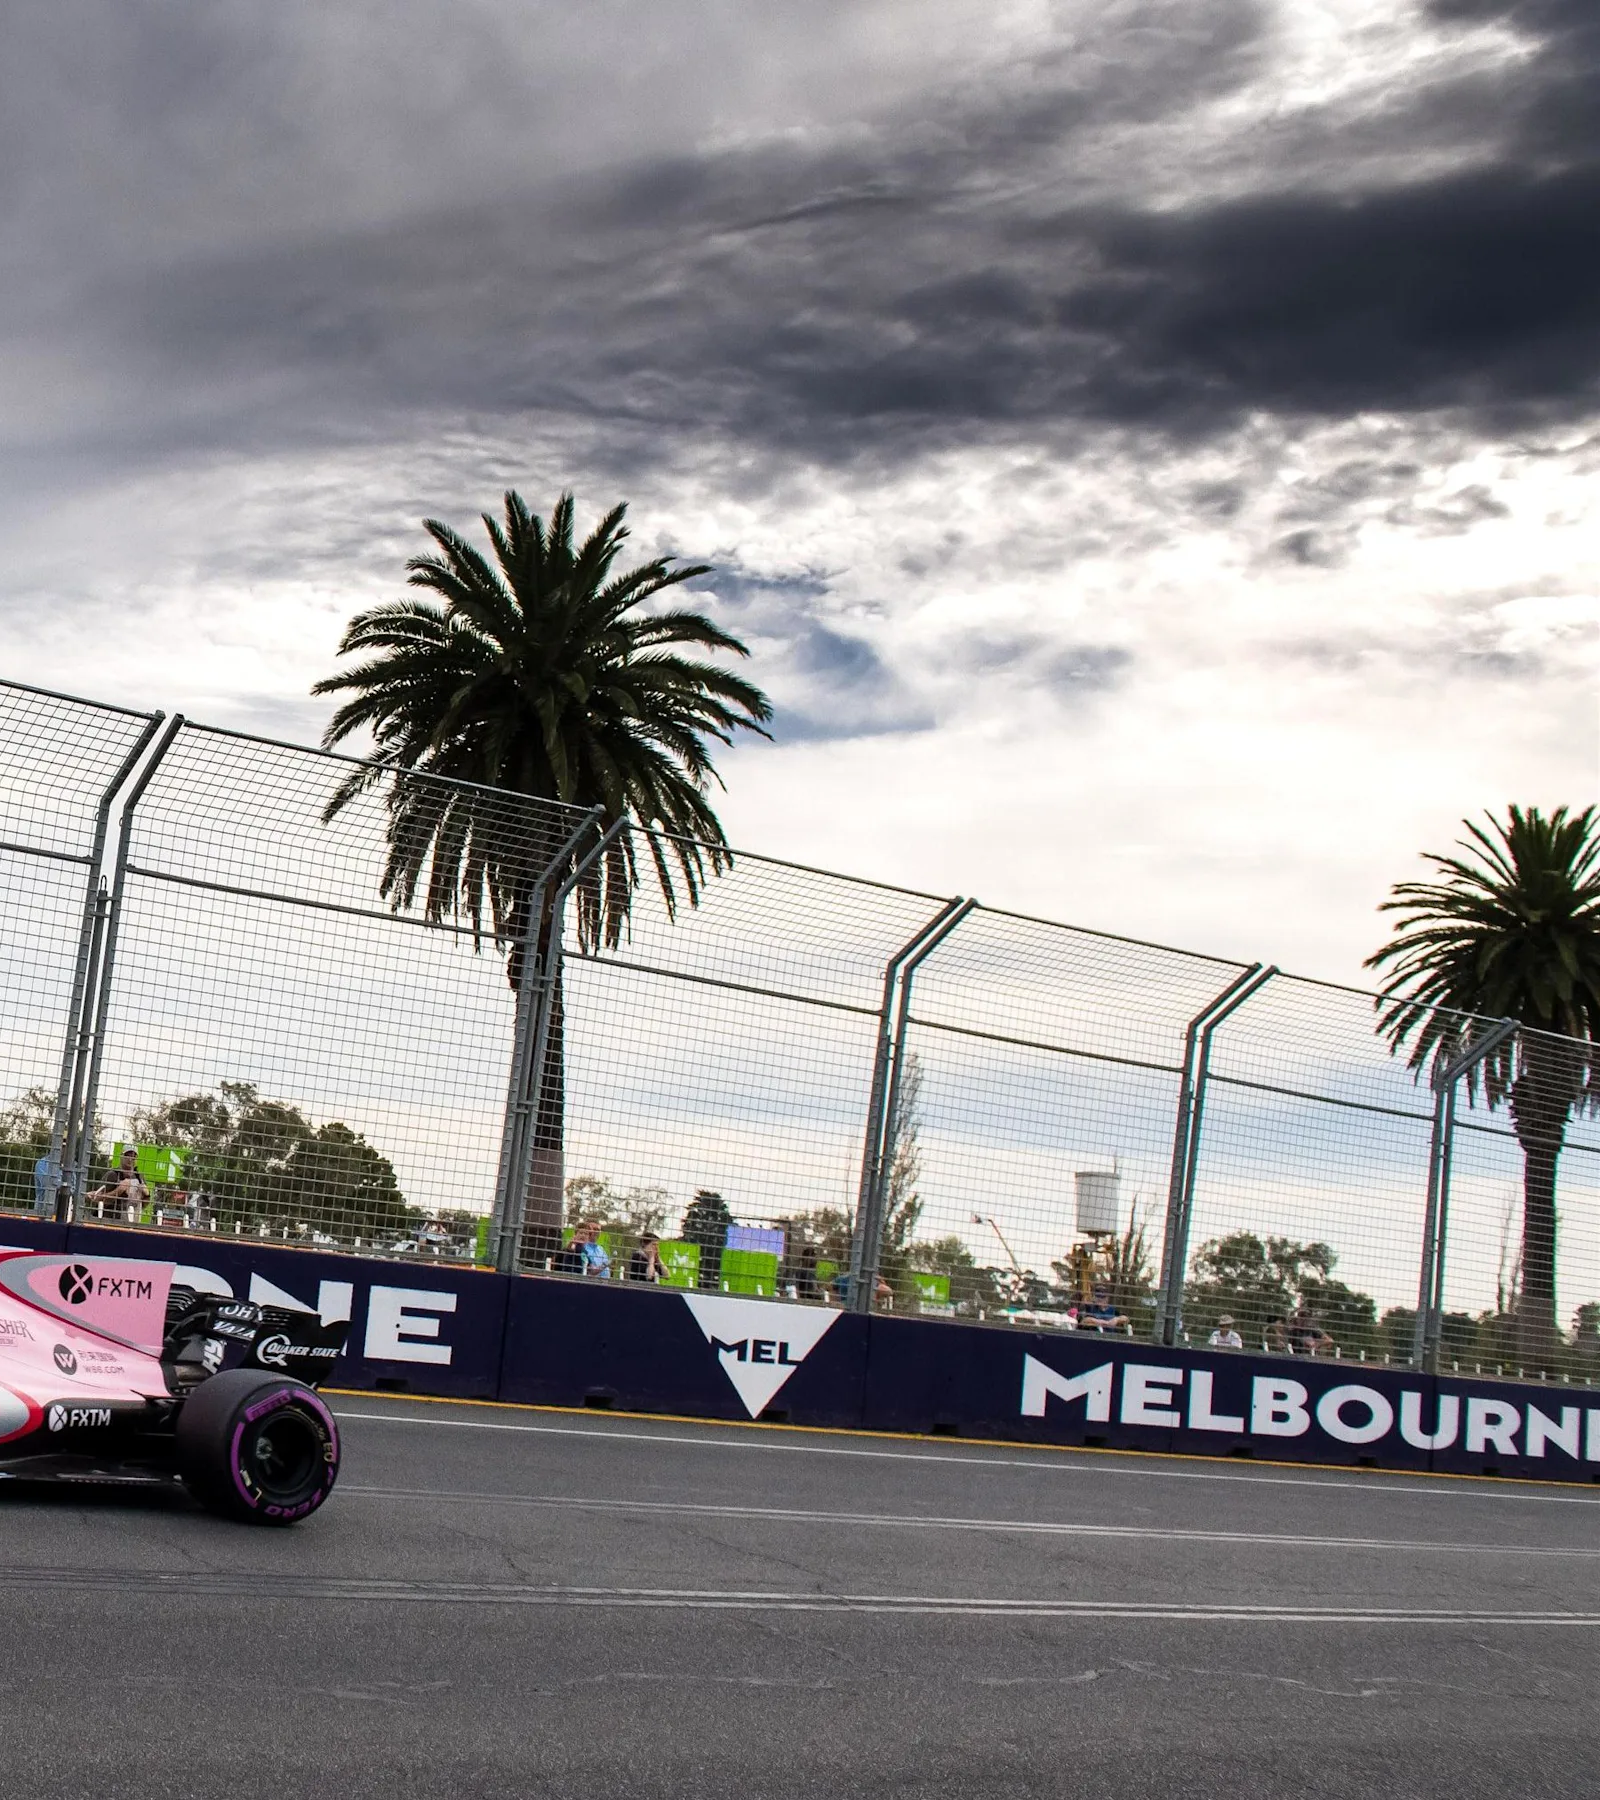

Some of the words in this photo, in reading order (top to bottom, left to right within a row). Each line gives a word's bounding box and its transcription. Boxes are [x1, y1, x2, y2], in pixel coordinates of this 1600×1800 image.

[97, 1277, 153, 1300] FXTM
[310, 1347, 341, 1359] STATE
[709, 1334, 802, 1366] MEL
[69, 1409, 112, 1427] FXTM
[1020, 1353, 1600, 1463] MELBOURN
